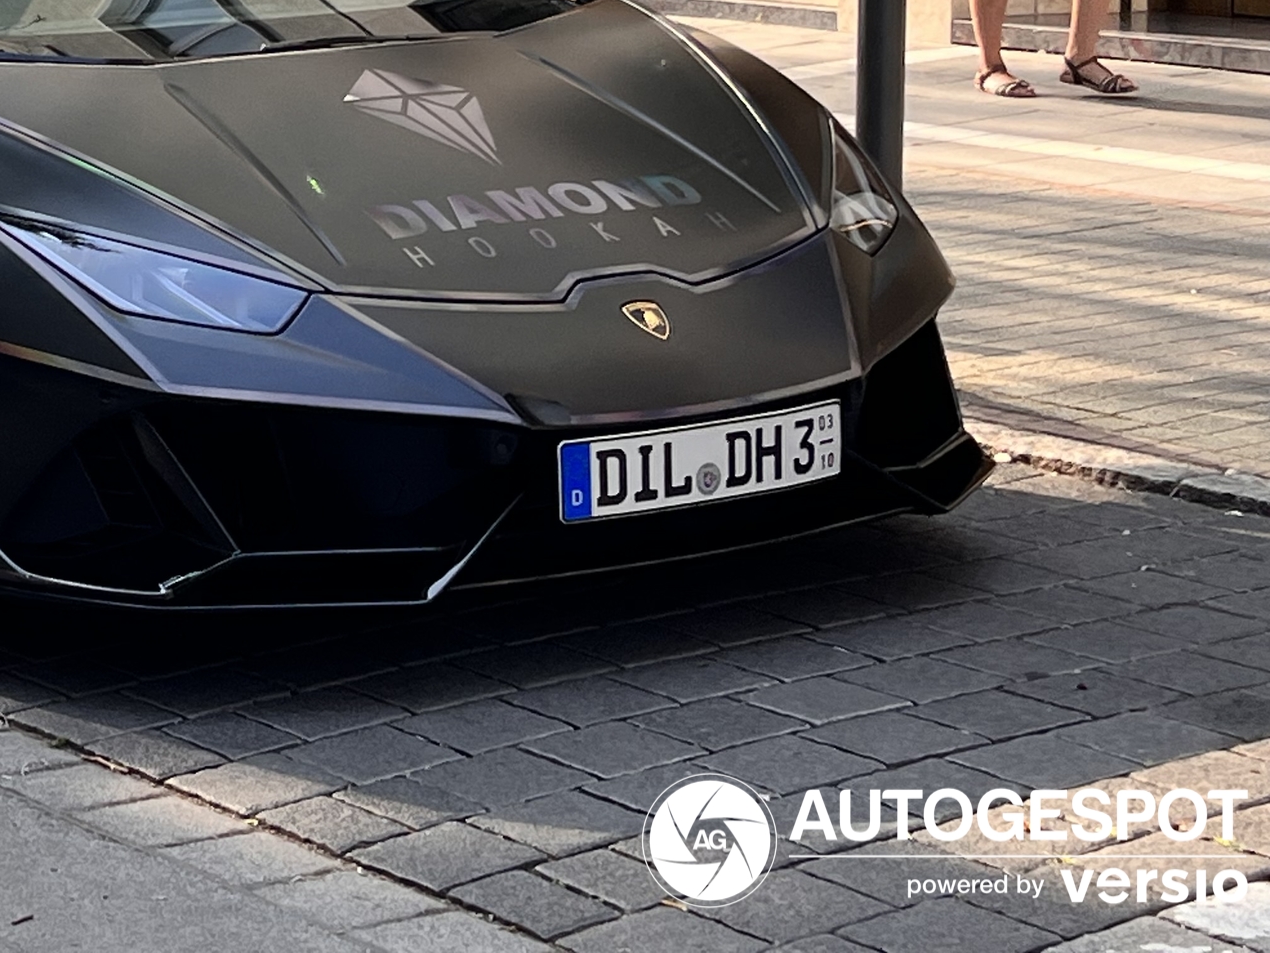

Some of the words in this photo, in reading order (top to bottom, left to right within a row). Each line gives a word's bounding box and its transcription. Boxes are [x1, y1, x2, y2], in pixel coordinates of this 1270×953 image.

[362, 174, 702, 240] DIAMOND
[402, 212, 737, 268] HOOKAH
[819, 414, 833, 431] 03
[596, 442, 692, 507] DIL
[725, 425, 782, 488] DH
[793, 418, 815, 475] 3
[821, 452, 834, 470] 10
[572, 490, 583, 506] D
